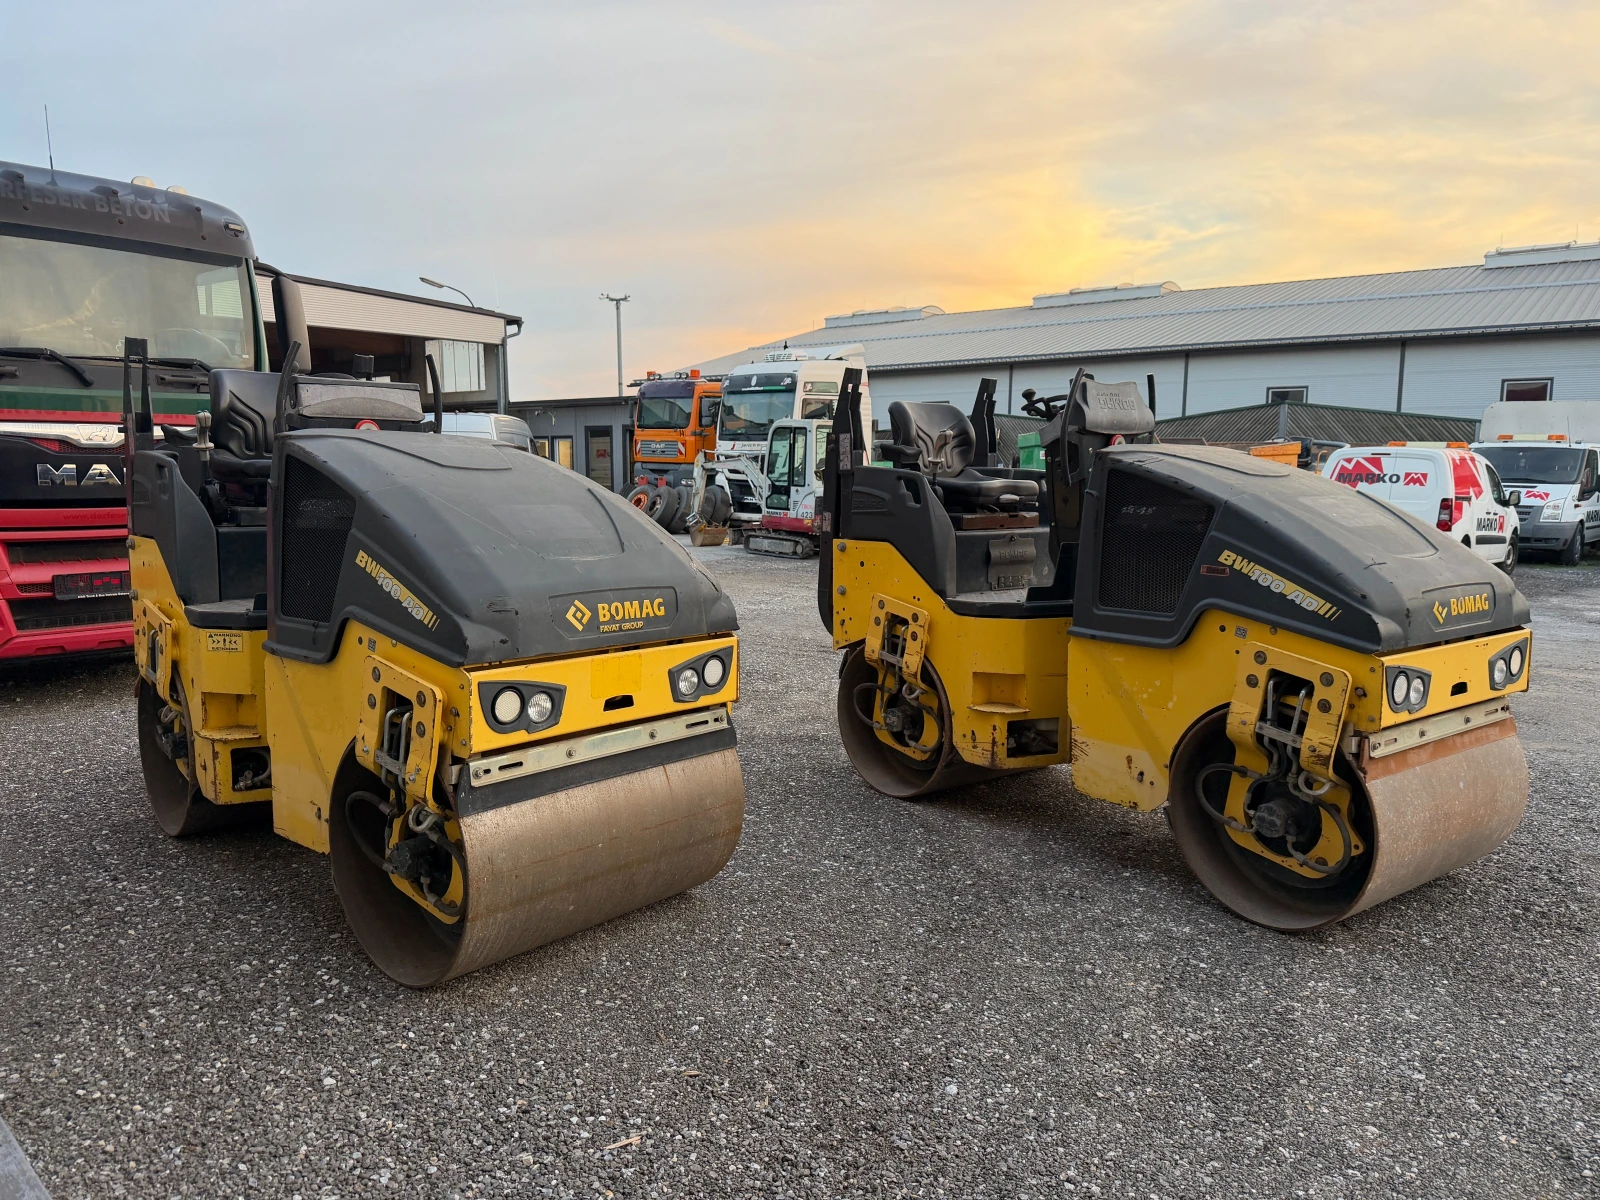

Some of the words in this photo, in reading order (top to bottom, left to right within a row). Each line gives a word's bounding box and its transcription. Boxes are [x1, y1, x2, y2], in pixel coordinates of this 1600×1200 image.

[95, 194, 171, 223] BETON
[36, 463, 127, 486] MA
[1337, 473, 1401, 484] MARKO
[1476, 517, 1498, 532] MARKO
[597, 598, 665, 622] BOMAG
[1450, 593, 1489, 616] BOMAG
[600, 624, 620, 633] FAYAT
[621, 621, 643, 630] GROUP
